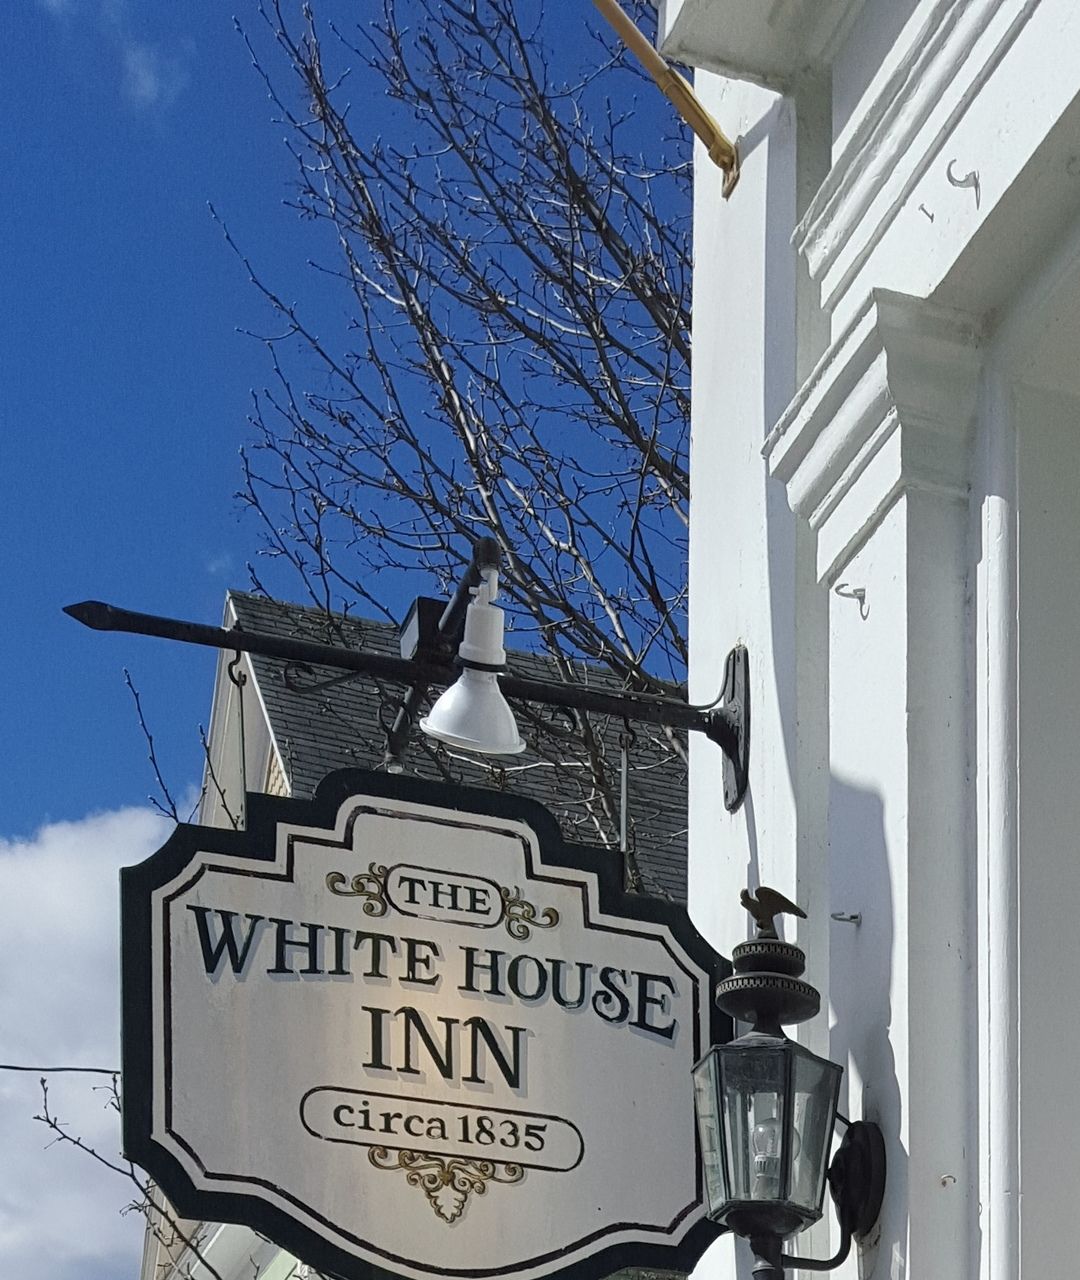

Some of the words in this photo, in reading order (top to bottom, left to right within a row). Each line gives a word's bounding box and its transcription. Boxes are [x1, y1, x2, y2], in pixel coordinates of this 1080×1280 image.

[397, 874, 493, 916] THE
[185, 904, 441, 986] WHITE
[457, 945, 678, 1041] HOUSE
[361, 1005, 528, 1089] INN
[332, 1098, 449, 1141] circa
[455, 1115, 549, 1153] 1835
